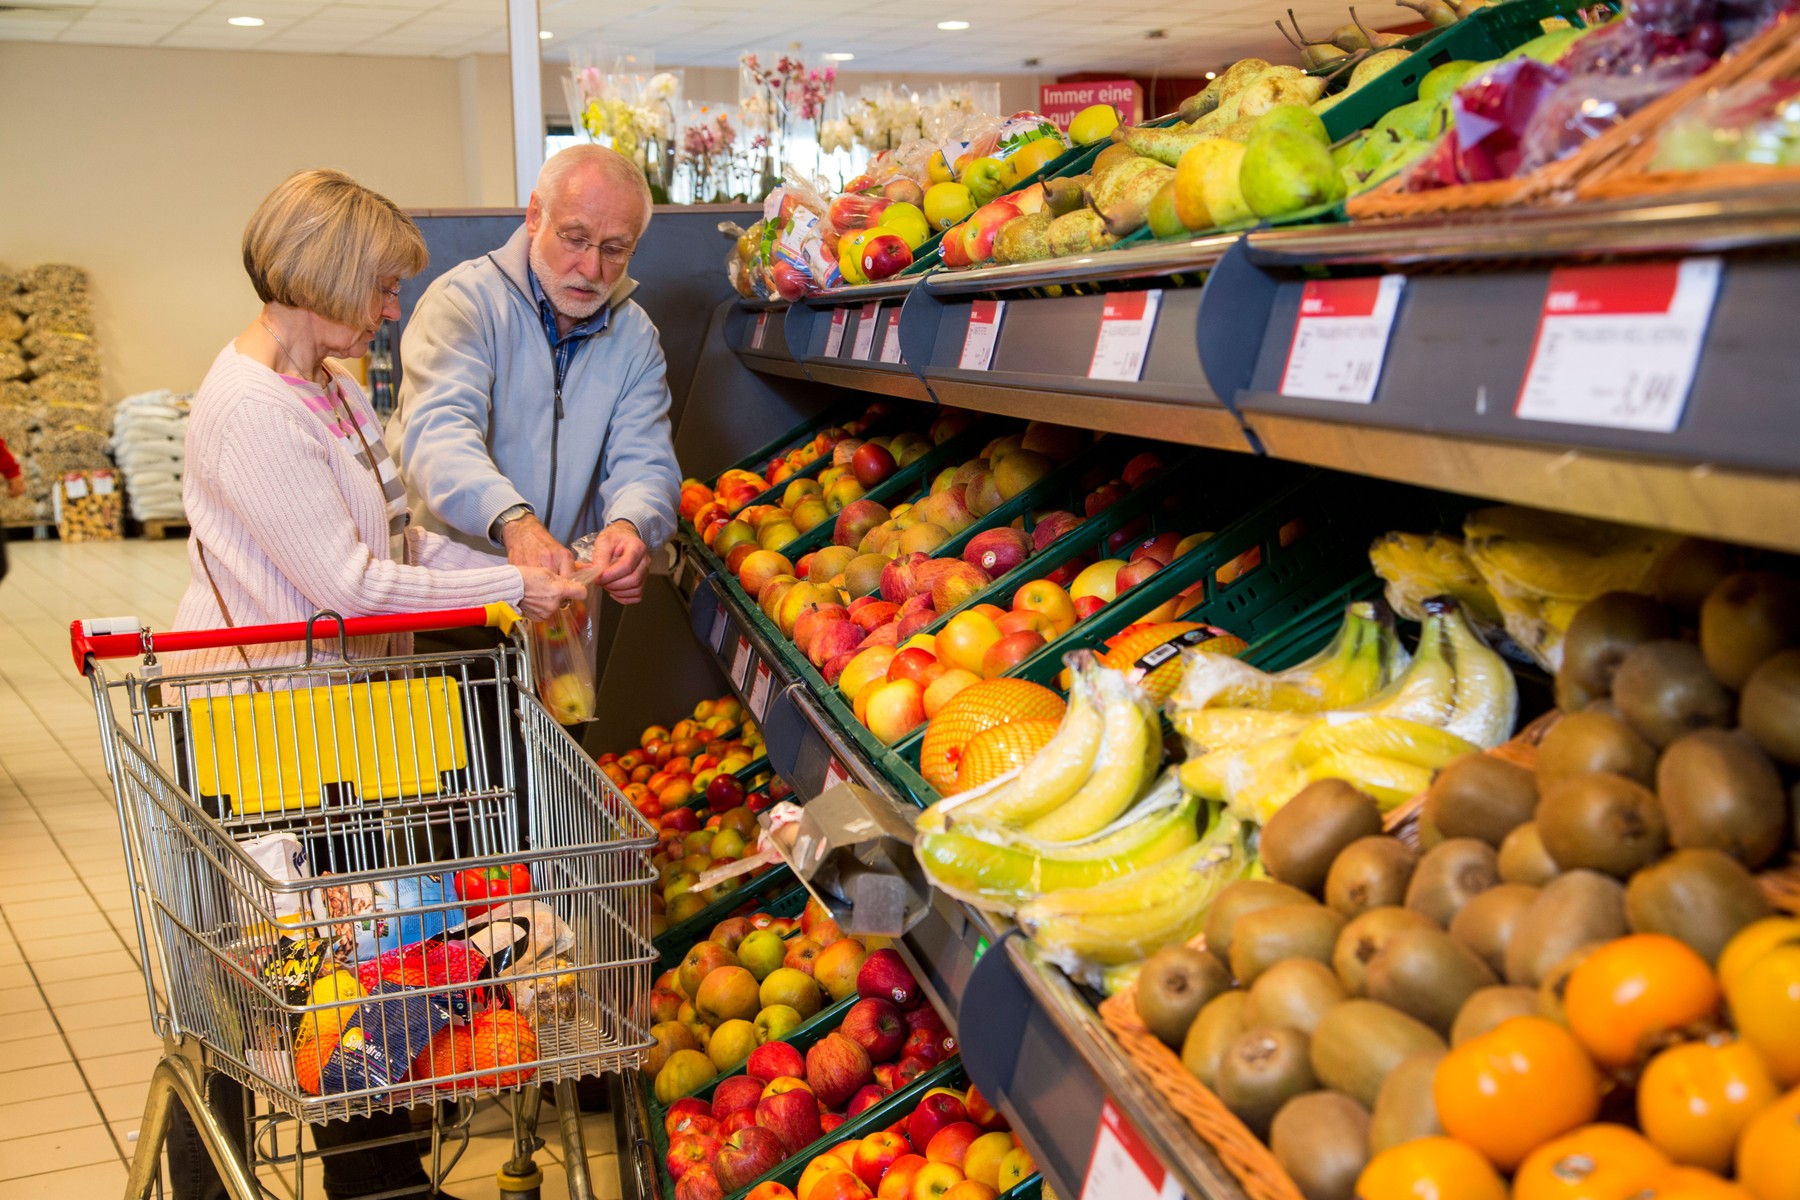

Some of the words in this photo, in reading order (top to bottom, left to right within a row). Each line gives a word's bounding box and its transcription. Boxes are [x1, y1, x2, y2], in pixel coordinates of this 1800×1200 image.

[1044, 88, 1094, 105] Immer
[1098, 84, 1132, 102] eine
[1050, 110, 1076, 126] gut
